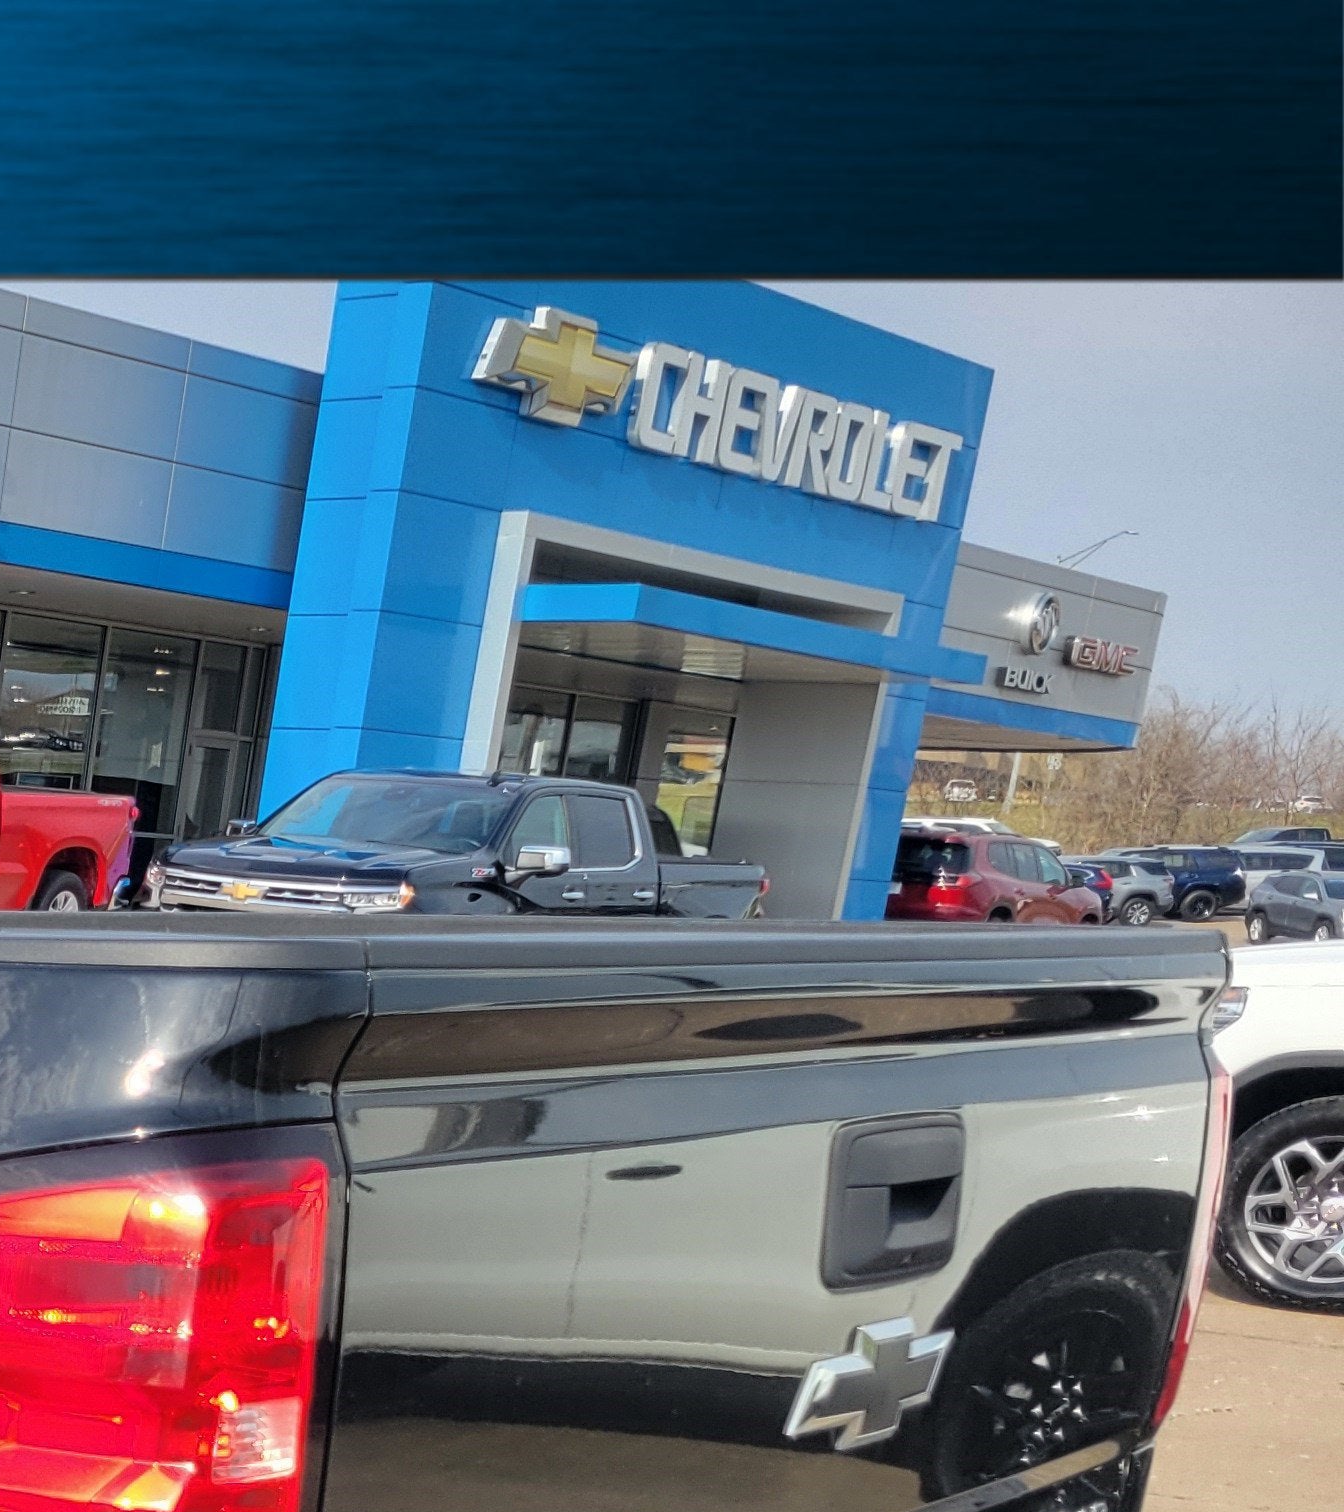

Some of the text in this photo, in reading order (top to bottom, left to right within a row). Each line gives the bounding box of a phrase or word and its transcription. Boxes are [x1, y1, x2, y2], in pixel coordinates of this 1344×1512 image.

[627, 341, 964, 522] CHEVROLET
[1070, 634, 1139, 676] GMC
[1002, 664, 1056, 695] BUICK
